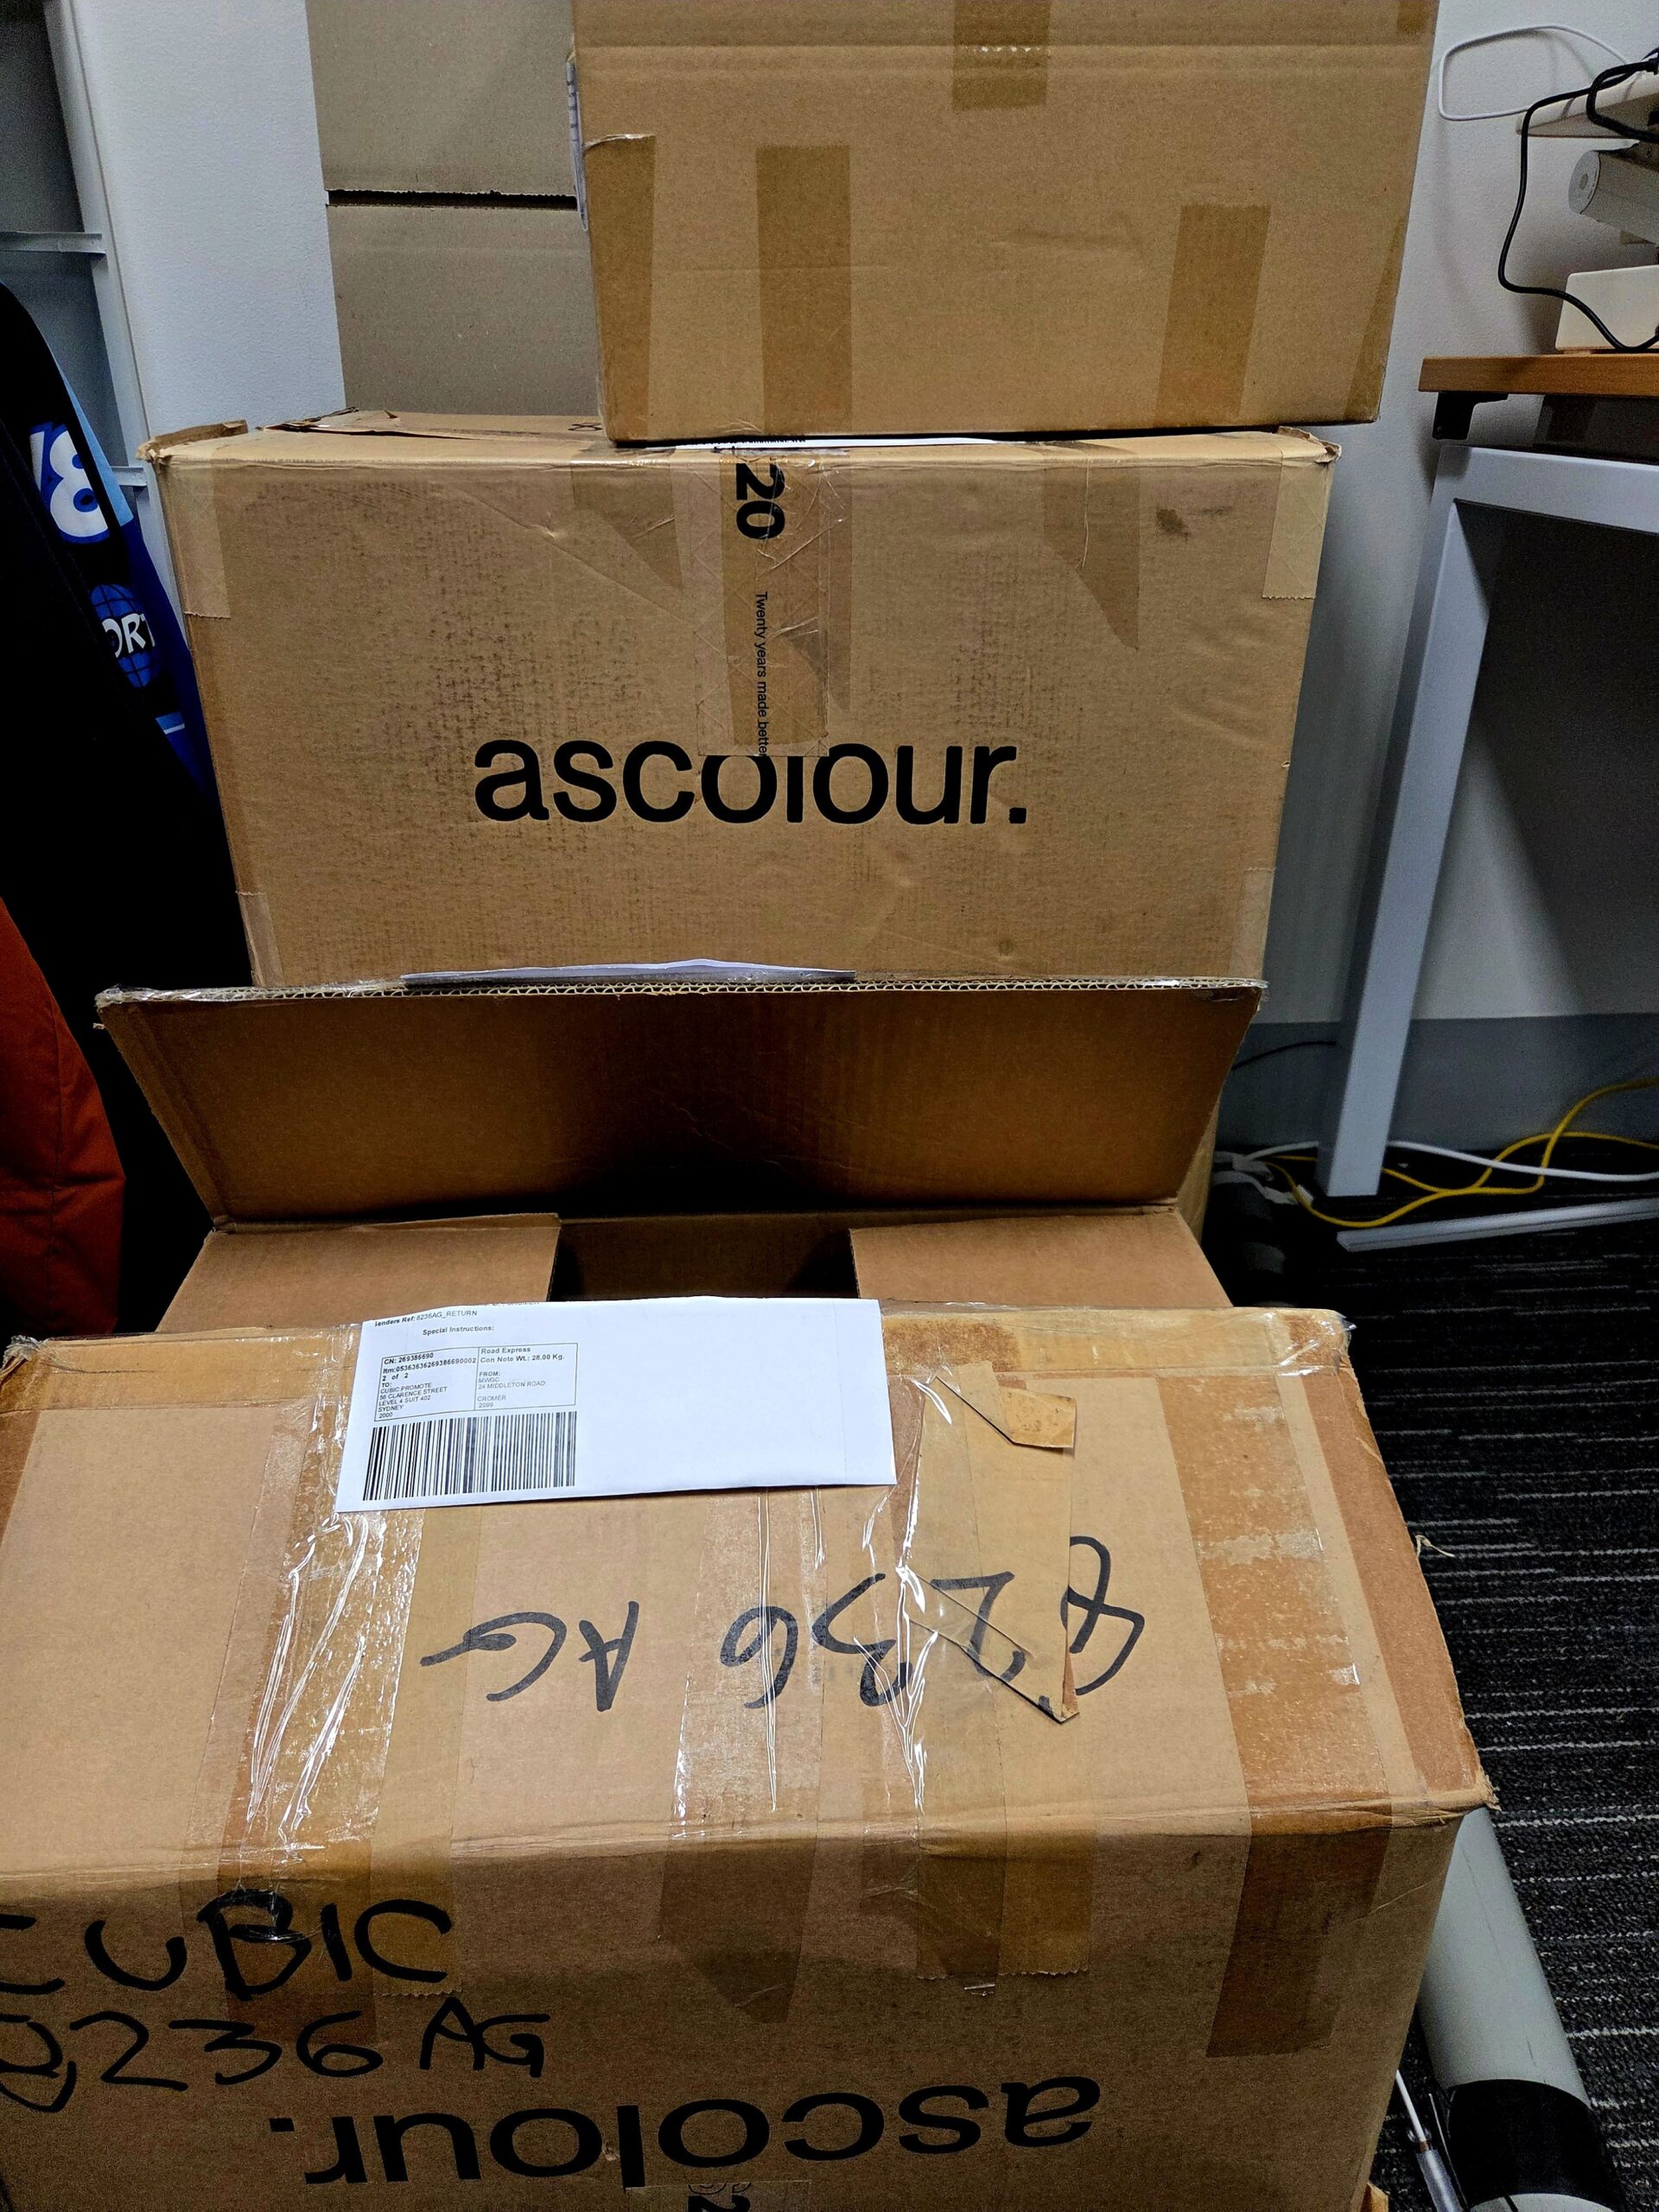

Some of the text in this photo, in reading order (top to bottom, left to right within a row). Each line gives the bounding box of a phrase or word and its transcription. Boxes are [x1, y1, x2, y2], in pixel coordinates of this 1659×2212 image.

[735, 461, 786, 540] 20
[754, 591, 768, 639] Twenty
[753, 639, 768, 677] years
[755, 679, 768, 719] made
[474, 739, 1027, 825] ascolour.
[416, 1310, 478, 1321] 8236AG_RETURN
[422, 1326, 448, 1336] Special
[398, 1352, 434, 1363] 269386690
[388, 1389, 422, 1399] CLARENCE
[400, 1382, 432, 1392] PROMOTE
[378, 1404, 404, 1413] SYDNEY
[418, 1997, 550, 2077] AG
[270, 2075, 1102, 2190] ascolour.
